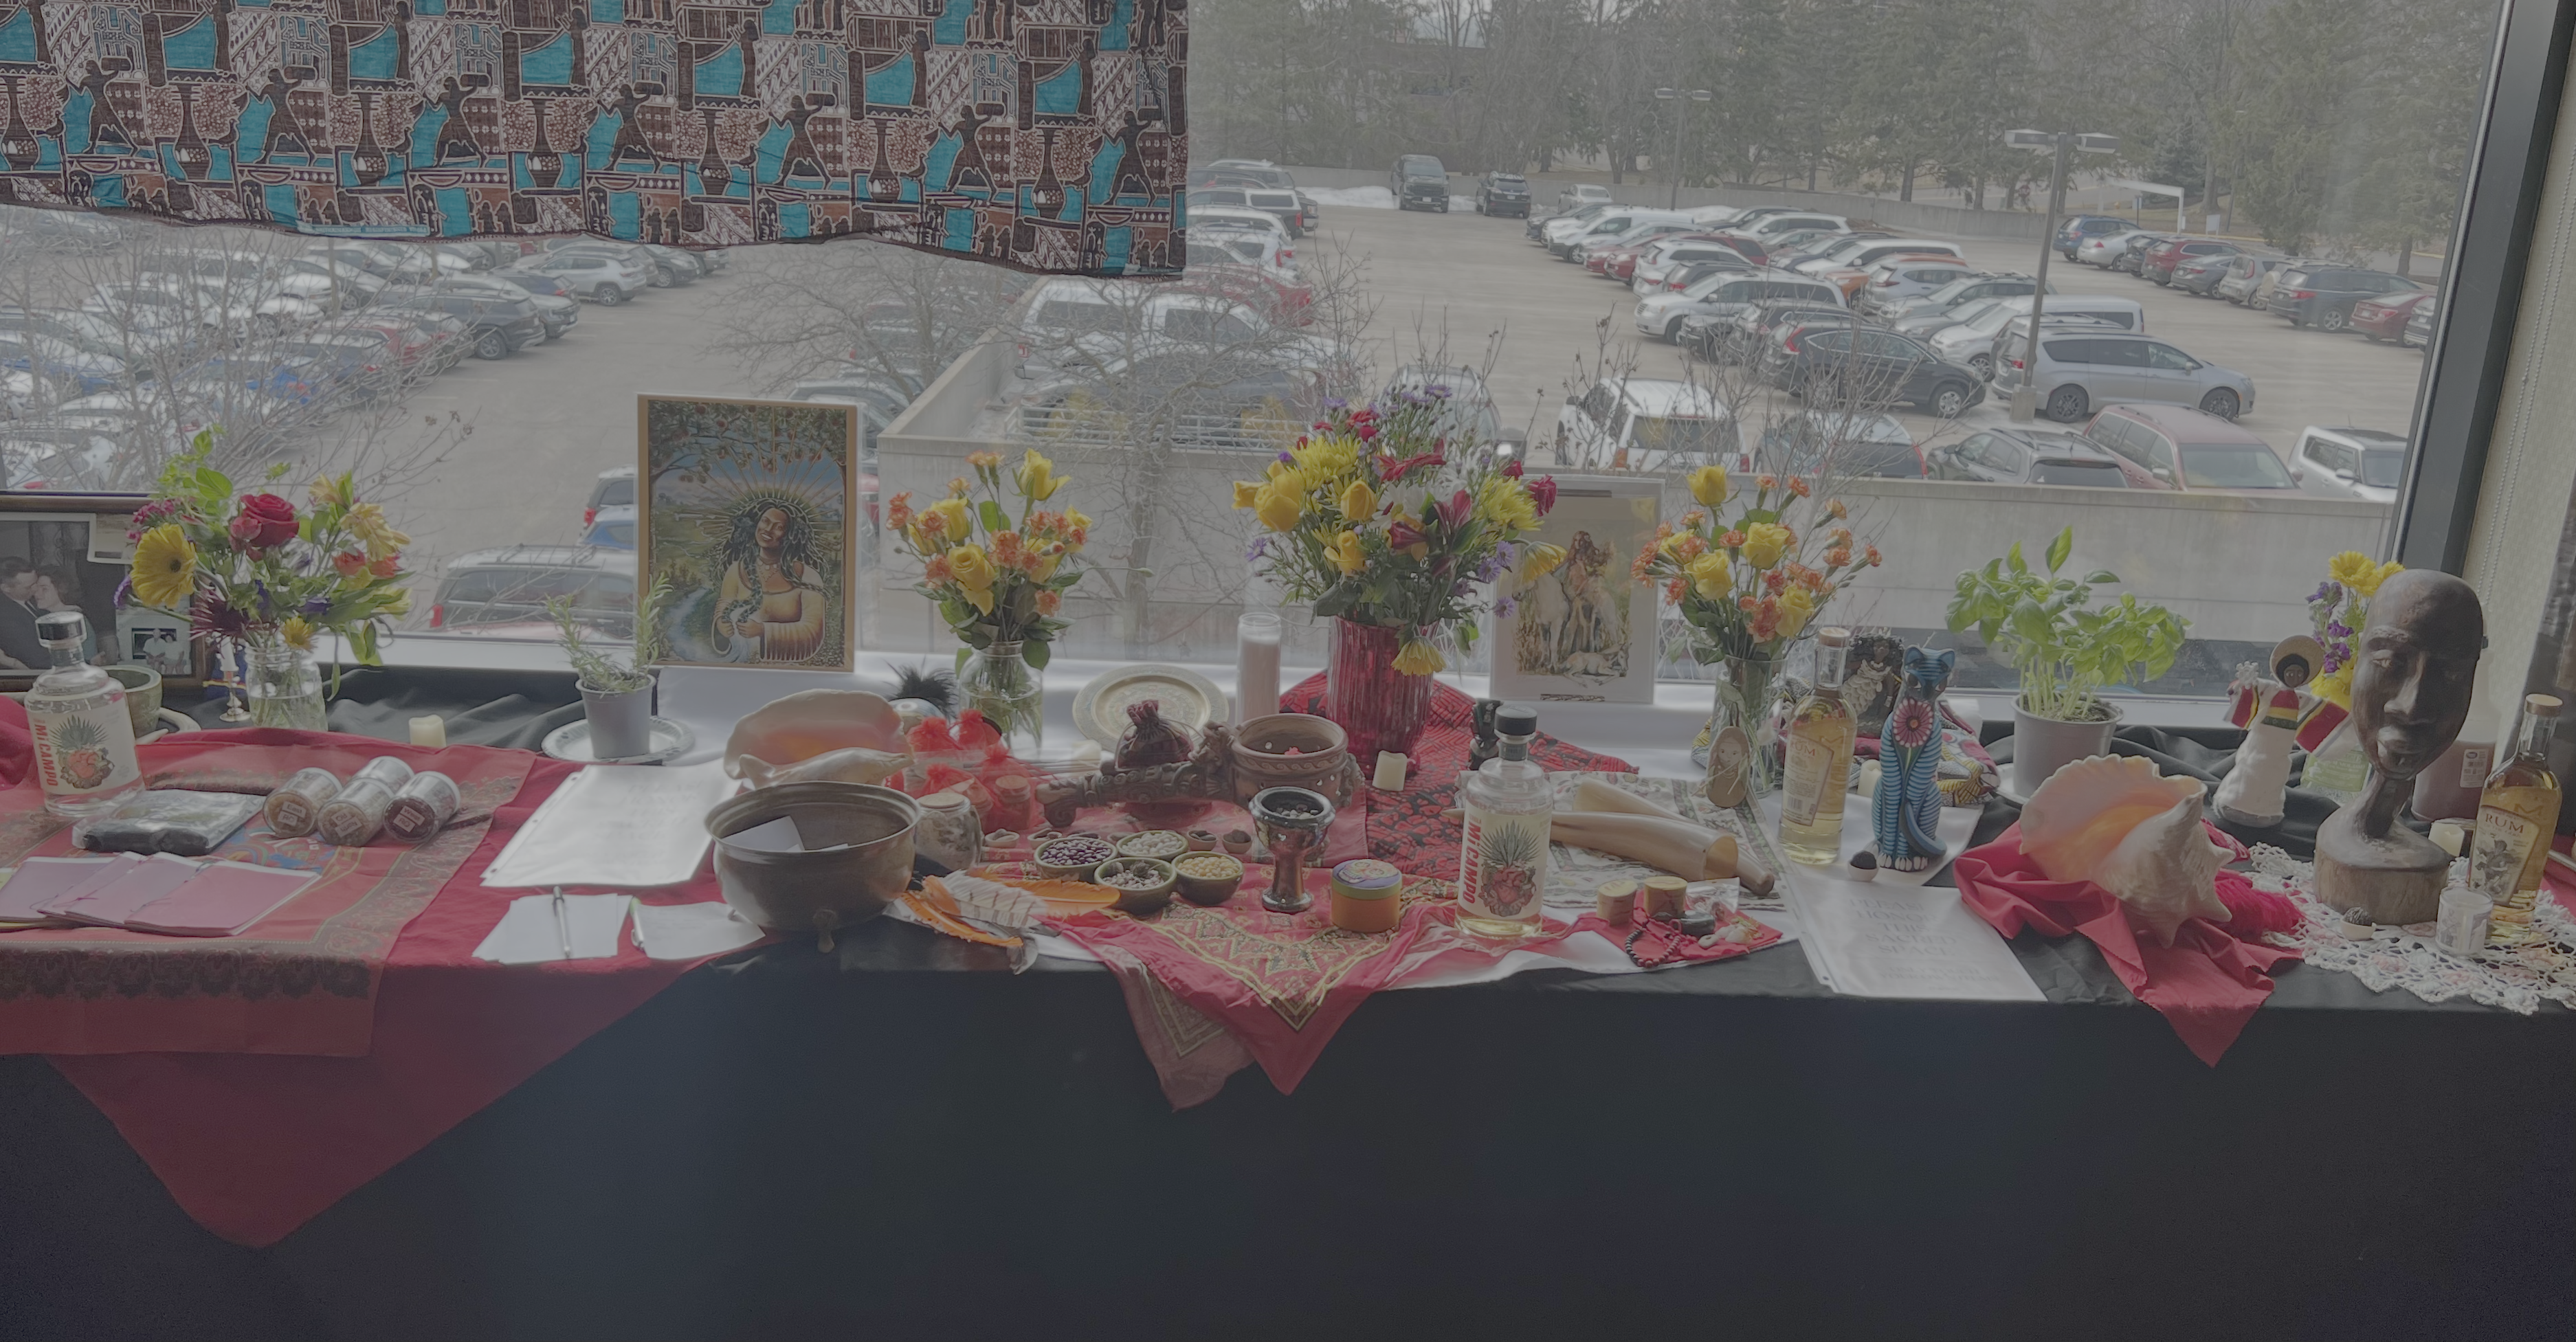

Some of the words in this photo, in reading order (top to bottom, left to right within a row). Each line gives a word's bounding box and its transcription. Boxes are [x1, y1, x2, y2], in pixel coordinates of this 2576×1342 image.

[1790, 740, 1816, 757] RUM
[38, 743, 58, 786] CAMPO
[2485, 813, 2524, 834] RUM
[1467, 823, 1481, 847] Mi
[1463, 847, 1479, 904] CAMPO
[1856, 910, 1937, 922] HONOR
[1878, 922, 1930, 933] THIS
[1865, 933, 1957, 946] SACRED
[1877, 945, 1956, 957] SPACE
